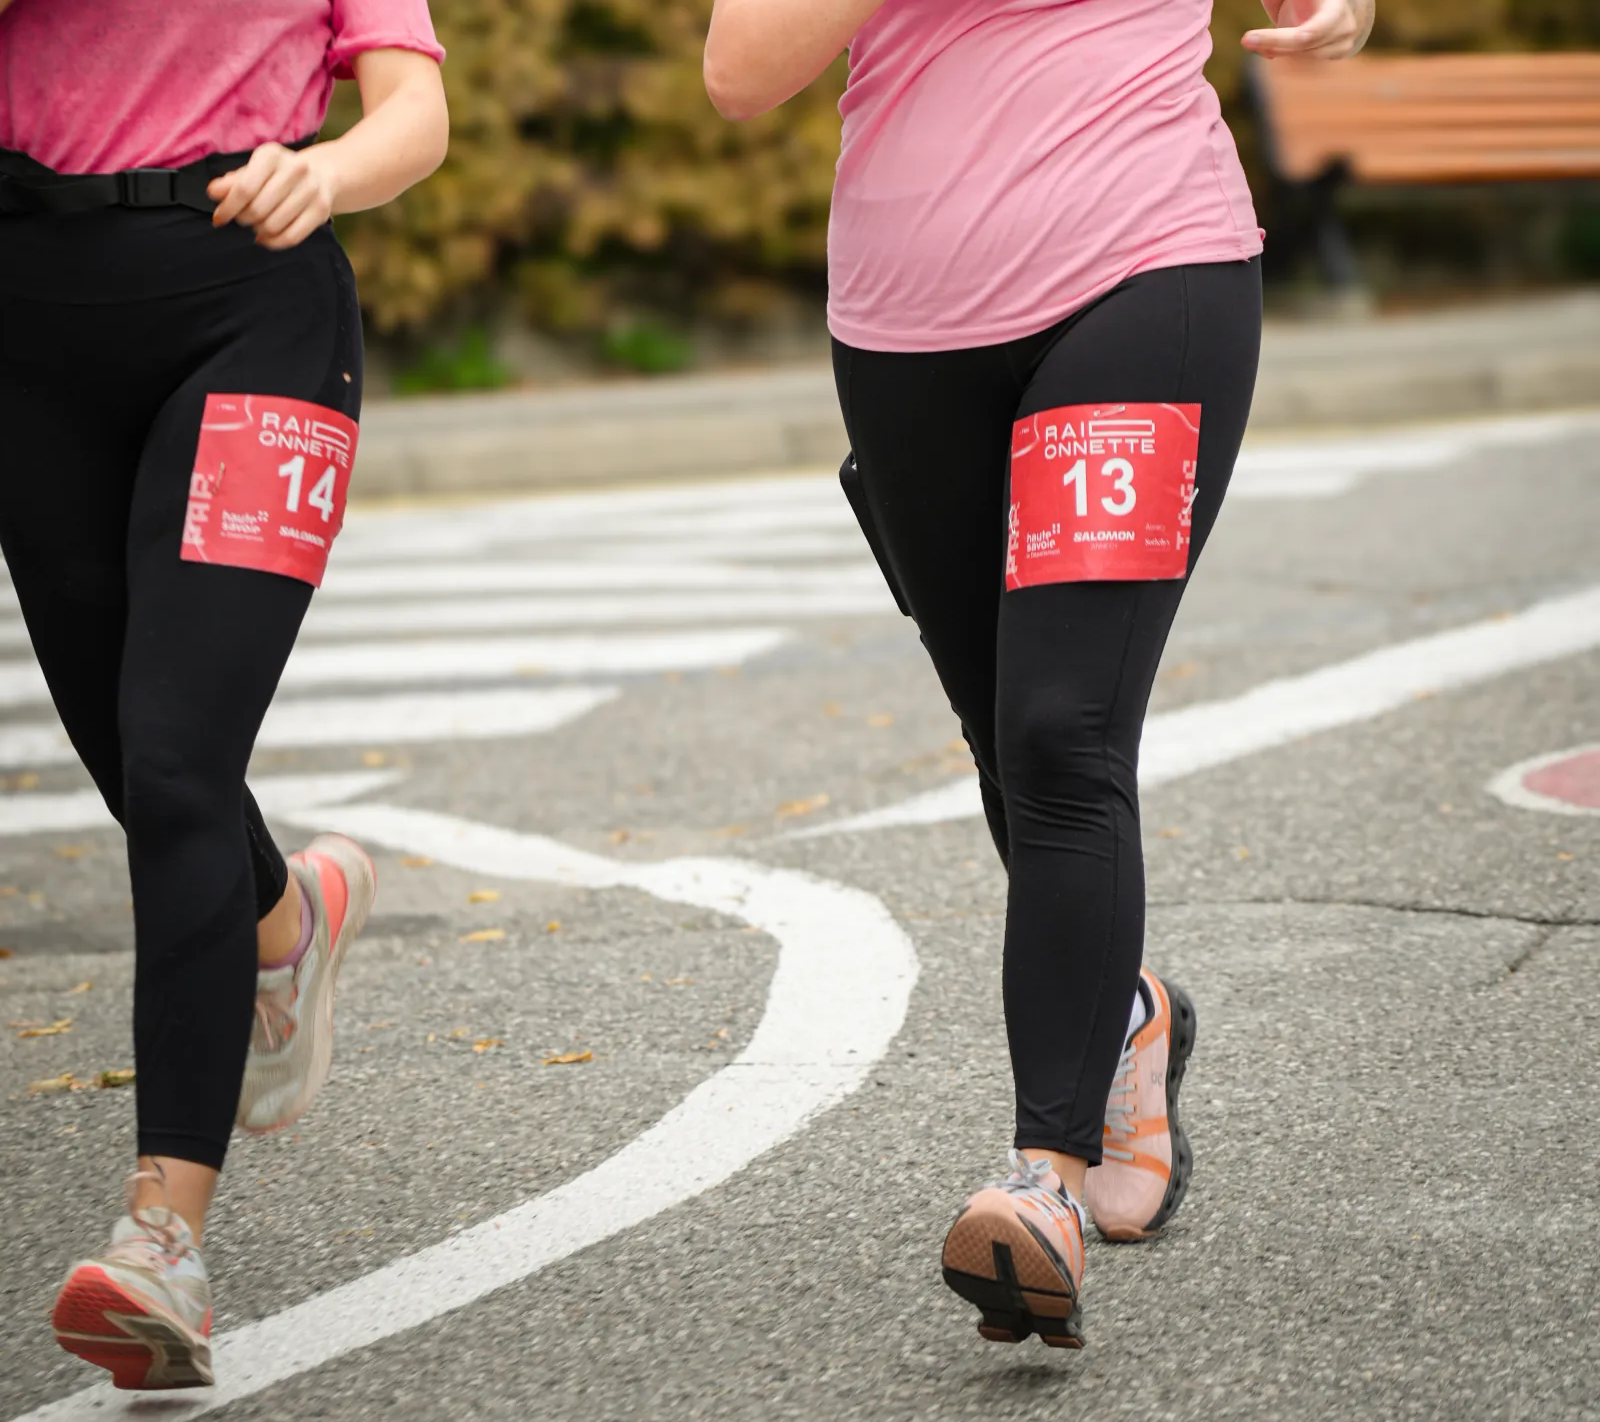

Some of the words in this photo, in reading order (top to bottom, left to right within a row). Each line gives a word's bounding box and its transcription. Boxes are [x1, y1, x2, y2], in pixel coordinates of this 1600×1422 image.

[262, 411, 351, 451] RAID
[1045, 419, 1155, 443] RAID
[258, 429, 350, 469] ONNETTE
[1044, 438, 1156, 460] ONNETTE
[278, 454, 337, 524] 14
[1063, 457, 1137, 518] 13
[1026, 530, 1052, 544] haute
[1026, 539, 1056, 553] savoie
[1073, 530, 1135, 543] SALOMON
